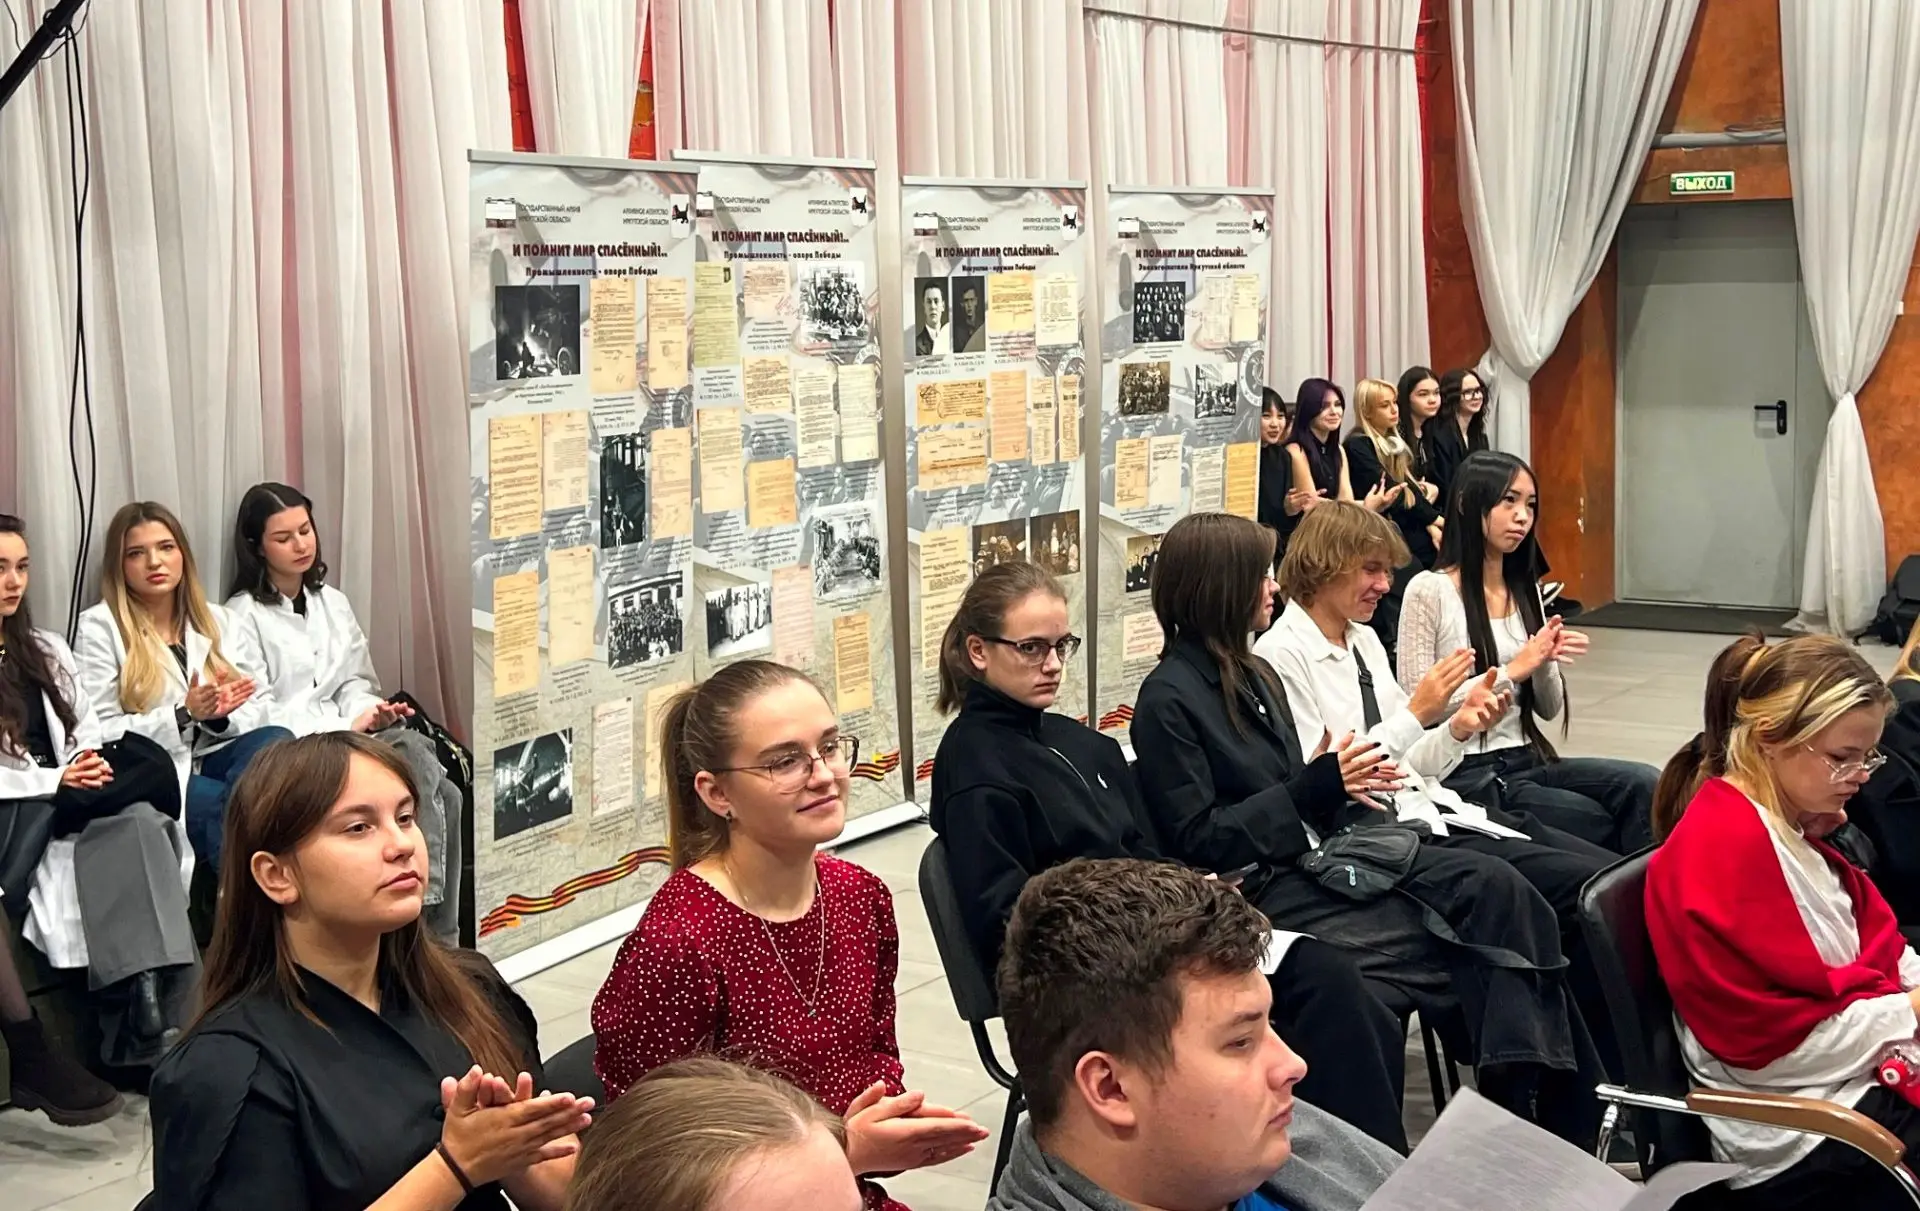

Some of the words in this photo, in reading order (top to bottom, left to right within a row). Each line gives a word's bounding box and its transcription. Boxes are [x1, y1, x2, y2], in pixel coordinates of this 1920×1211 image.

[1676, 176, 1727, 191] ВЫХОД
[712, 230, 719, 242] И
[721, 231, 761, 243] ПОМНИТ
[763, 232, 785, 243] МИР
[512, 243, 521, 257] И
[523, 243, 571, 257] ПОМНИТ
[573, 244, 596, 257] МИР
[724, 251, 787, 261] Промышленность
[792, 252, 813, 260] опора
[814, 250, 842, 259] Победы
[935, 247, 942, 258] И
[943, 246, 980, 257] ПОМНИТ
[981, 247, 1001, 257] МИР
[1135, 248, 1142, 258] И
[1143, 249, 1177, 258] ПОМНИТ
[1178, 248, 1195, 258] МИР
[526, 267, 596, 278] Промышленность
[603, 268, 627, 277] опора
[628, 266, 658, 276] Победы
